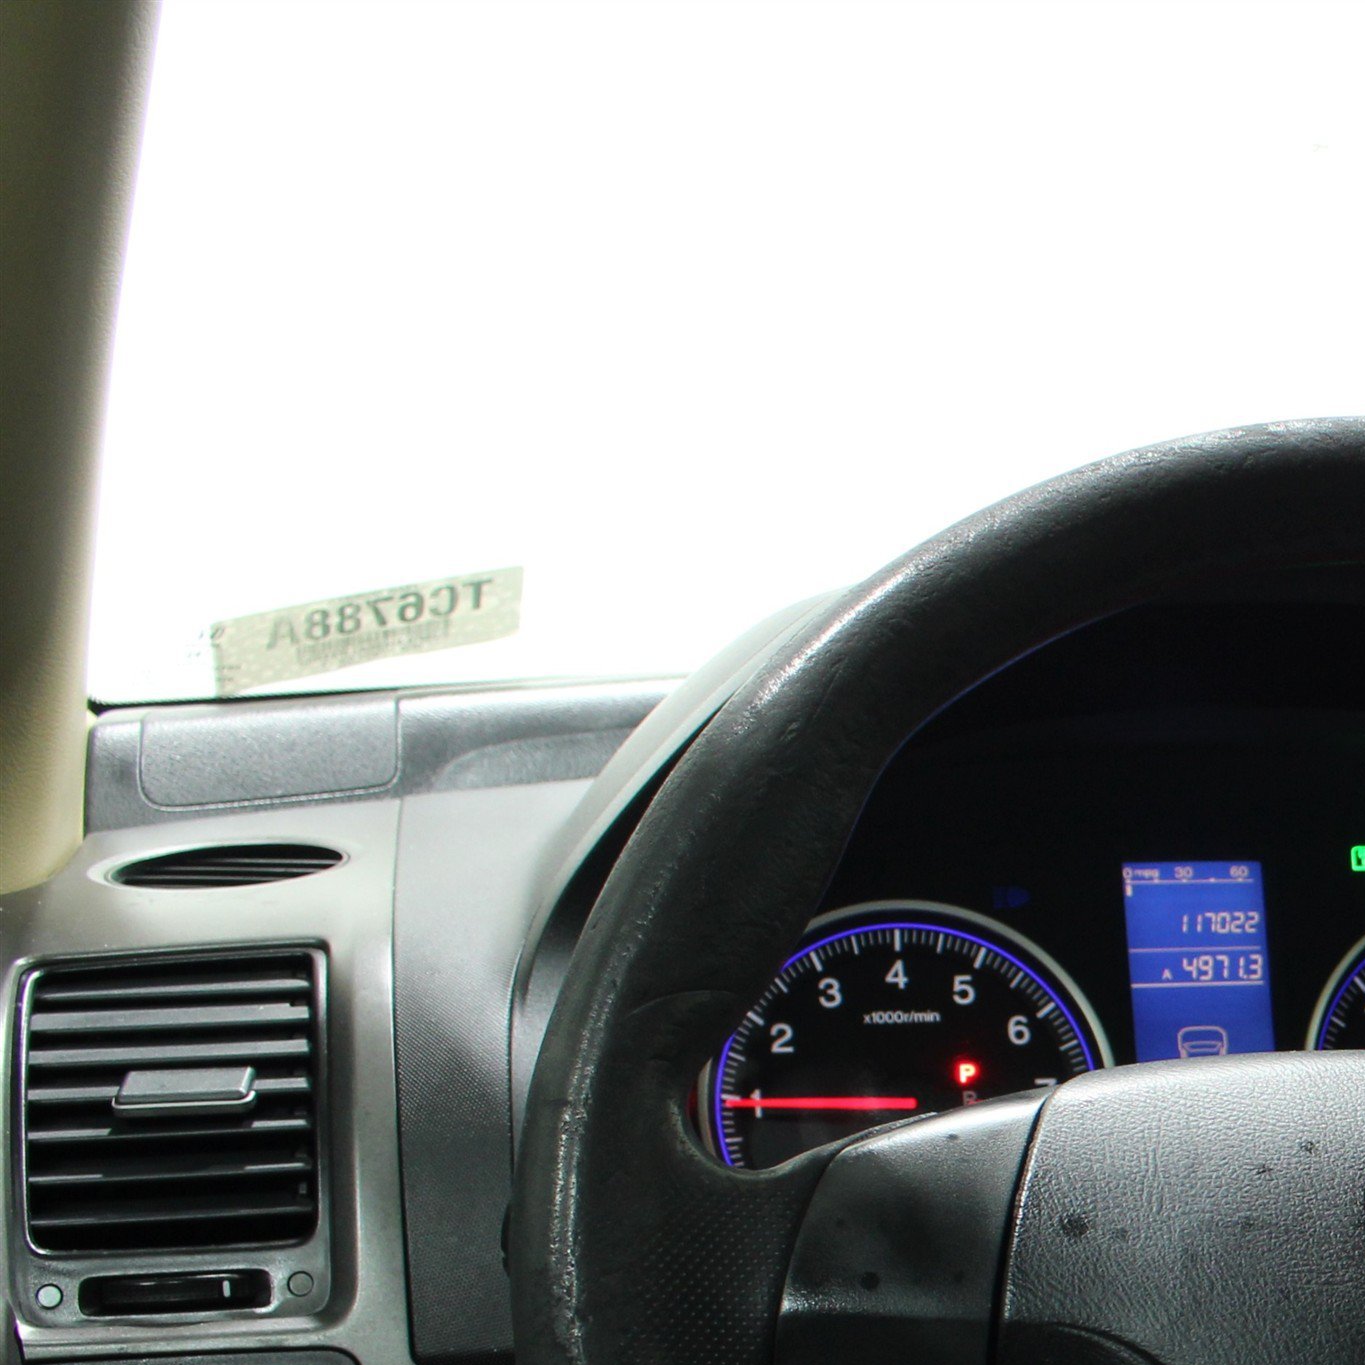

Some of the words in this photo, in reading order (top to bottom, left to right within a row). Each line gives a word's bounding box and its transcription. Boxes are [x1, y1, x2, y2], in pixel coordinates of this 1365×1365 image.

[1182, 911, 1260, 934] 117022
[884, 959, 909, 990] 4
[952, 974, 976, 1006] 5
[818, 977, 843, 1008] 3
[863, 1010, 941, 1025] x1000r/min
[1007, 1015, 1031, 1046] 6
[770, 1023, 795, 1054] 2
[959, 1063, 977, 1084] P
